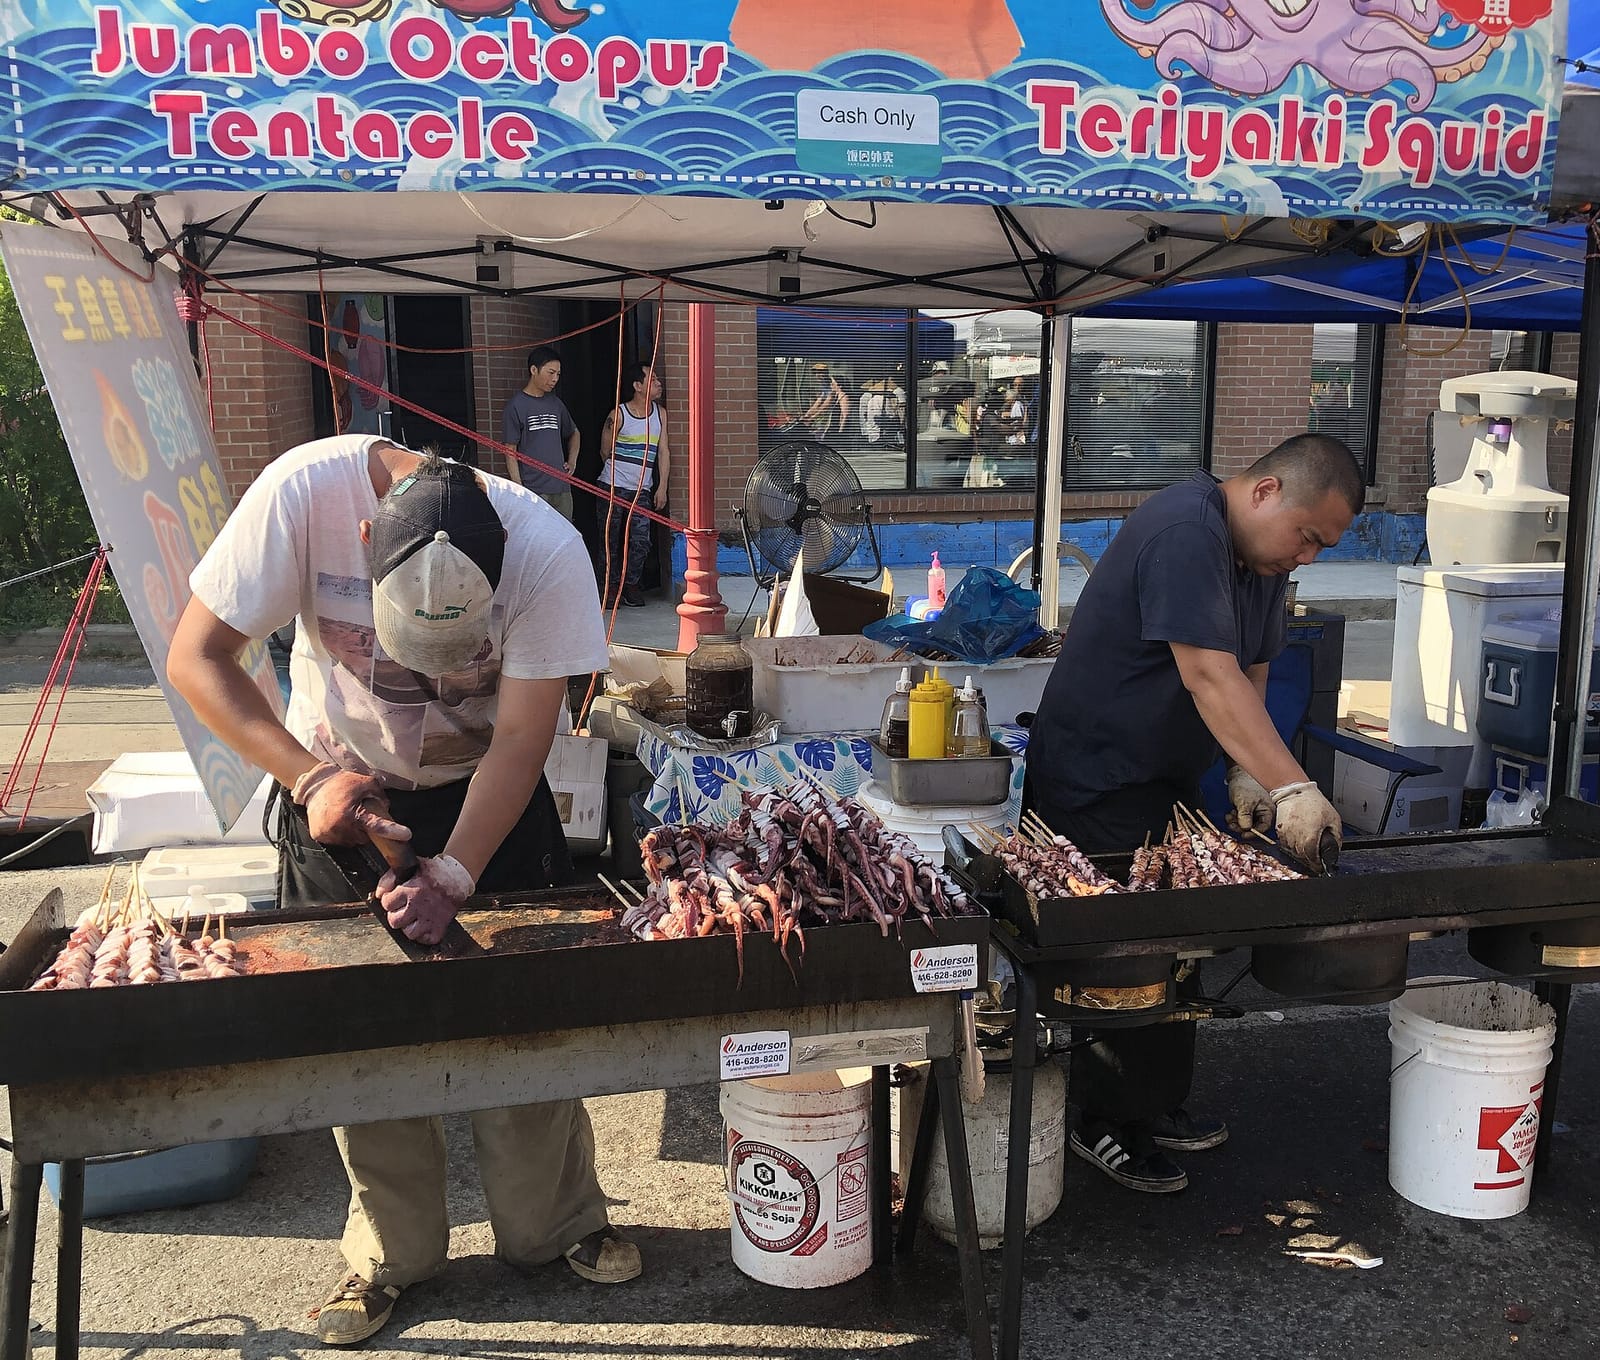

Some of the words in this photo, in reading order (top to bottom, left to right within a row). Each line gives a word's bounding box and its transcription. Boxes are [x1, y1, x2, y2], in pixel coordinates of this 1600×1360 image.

[93, 8, 368, 78] Jumbo
[389, 16, 728, 99] Octopus
[151, 90, 538, 164] Tentacle
[820, 105, 867, 124] Cash
[874, 107, 915, 131] Only
[1026, 79, 1347, 181] Teriyaki
[1361, 100, 1544, 189] Squid
[925, 955, 975, 969] Anderson
[917, 968, 973, 982] 416-628-8200
[735, 1040, 787, 1054] Anderson
[725, 1053, 785, 1068] 416-628-8200
[739, 1176, 799, 1202] KIKKOMAN
[771, 1211, 795, 1225] Soja
